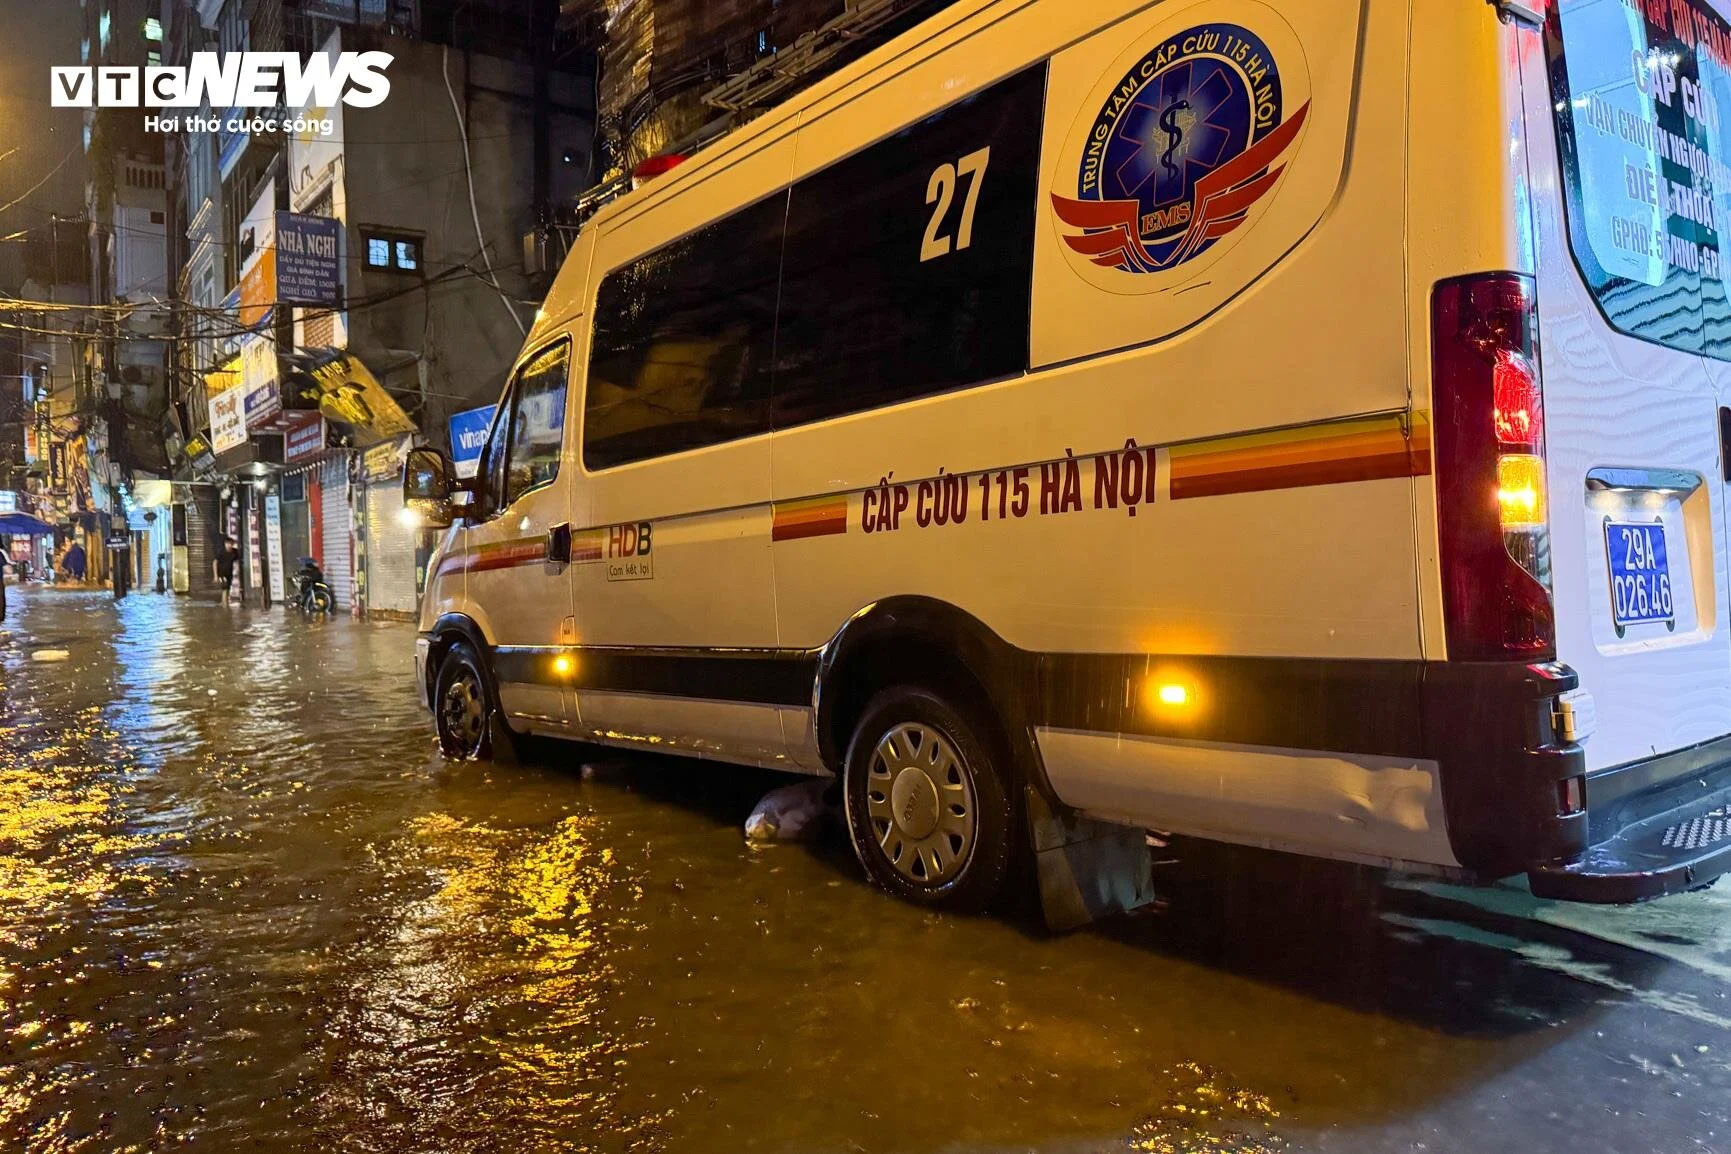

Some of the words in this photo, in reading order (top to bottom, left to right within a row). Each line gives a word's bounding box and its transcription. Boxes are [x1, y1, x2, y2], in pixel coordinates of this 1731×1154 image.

[1183, 29, 1220, 53] CỨU
[1223, 36, 1251, 61] 115
[1141, 44, 1177, 78] CẤP
[1245, 53, 1271, 83] HÀ
[1105, 78, 1140, 117] TÂM
[1256, 87, 1276, 128] NỘI
[1584, 90, 1616, 137] VẬN
[1083, 124, 1109, 193] TRUNG
[920, 145, 990, 262] 27
[1141, 202, 1192, 235] EMS
[279, 226, 304, 253] NHÀ
[306, 228, 336, 258] NGHỈ
[862, 471, 908, 533] CẤP
[917, 467, 968, 527] CỨU
[979, 467, 1029, 520] 115
[1040, 448, 1082, 515] HÀ
[1094, 438, 1156, 517] NỘI
[609, 523, 651, 558] HDB
[1622, 528, 1656, 571] 29A
[1614, 573, 1673, 618] 026.46
